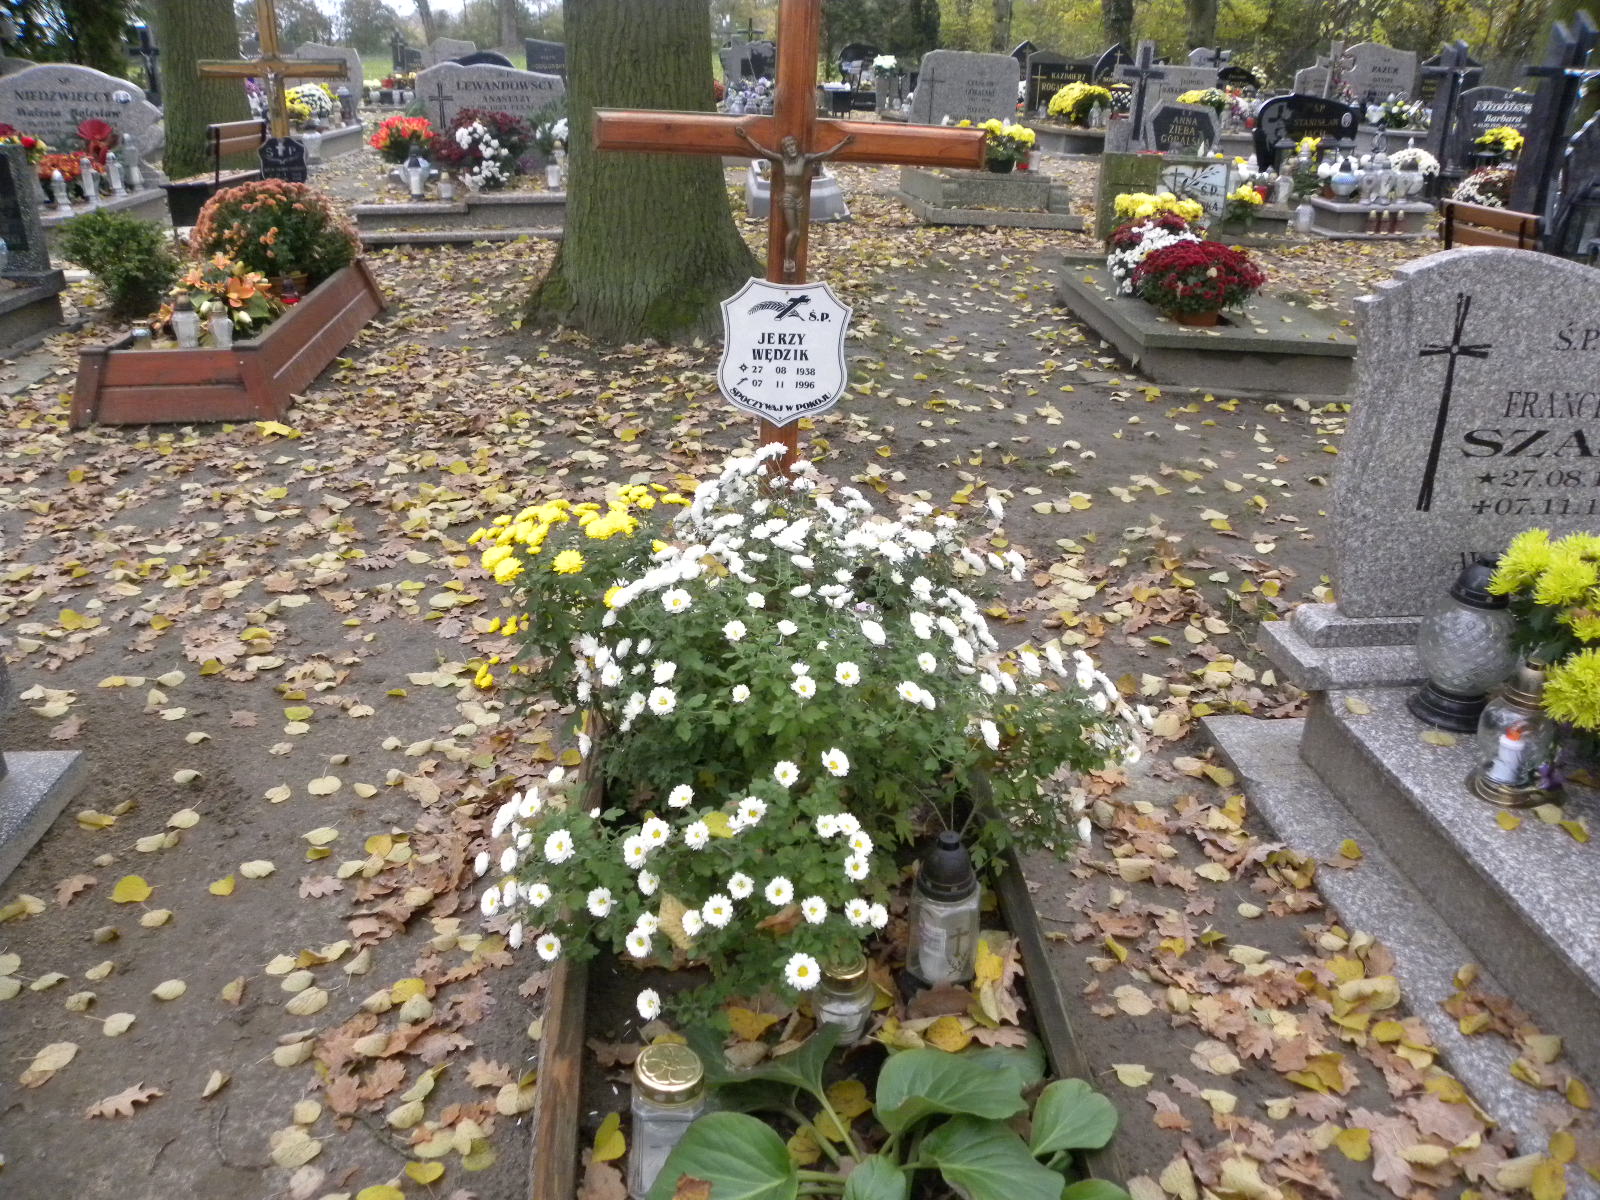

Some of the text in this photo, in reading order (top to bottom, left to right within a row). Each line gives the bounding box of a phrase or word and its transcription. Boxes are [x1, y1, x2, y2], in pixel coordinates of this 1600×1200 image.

[456, 81, 554, 90] LEWANDOWSCY
[1173, 117, 1197, 125] ANNA
[1484, 114, 1523, 123] Barbara
[758, 333, 806, 345] JERZY
[752, 349, 809, 362] WĘDZIK
[775, 366, 786, 374] 08
[796, 367, 815, 376] 1938
[776, 380, 784, 388] 11
[795, 381, 815, 389] 1996
[730, 387, 783, 411] SPOCZYWAJ
[795, 392, 832, 411] POKOJU
[1460, 429, 1600, 457] SZA
